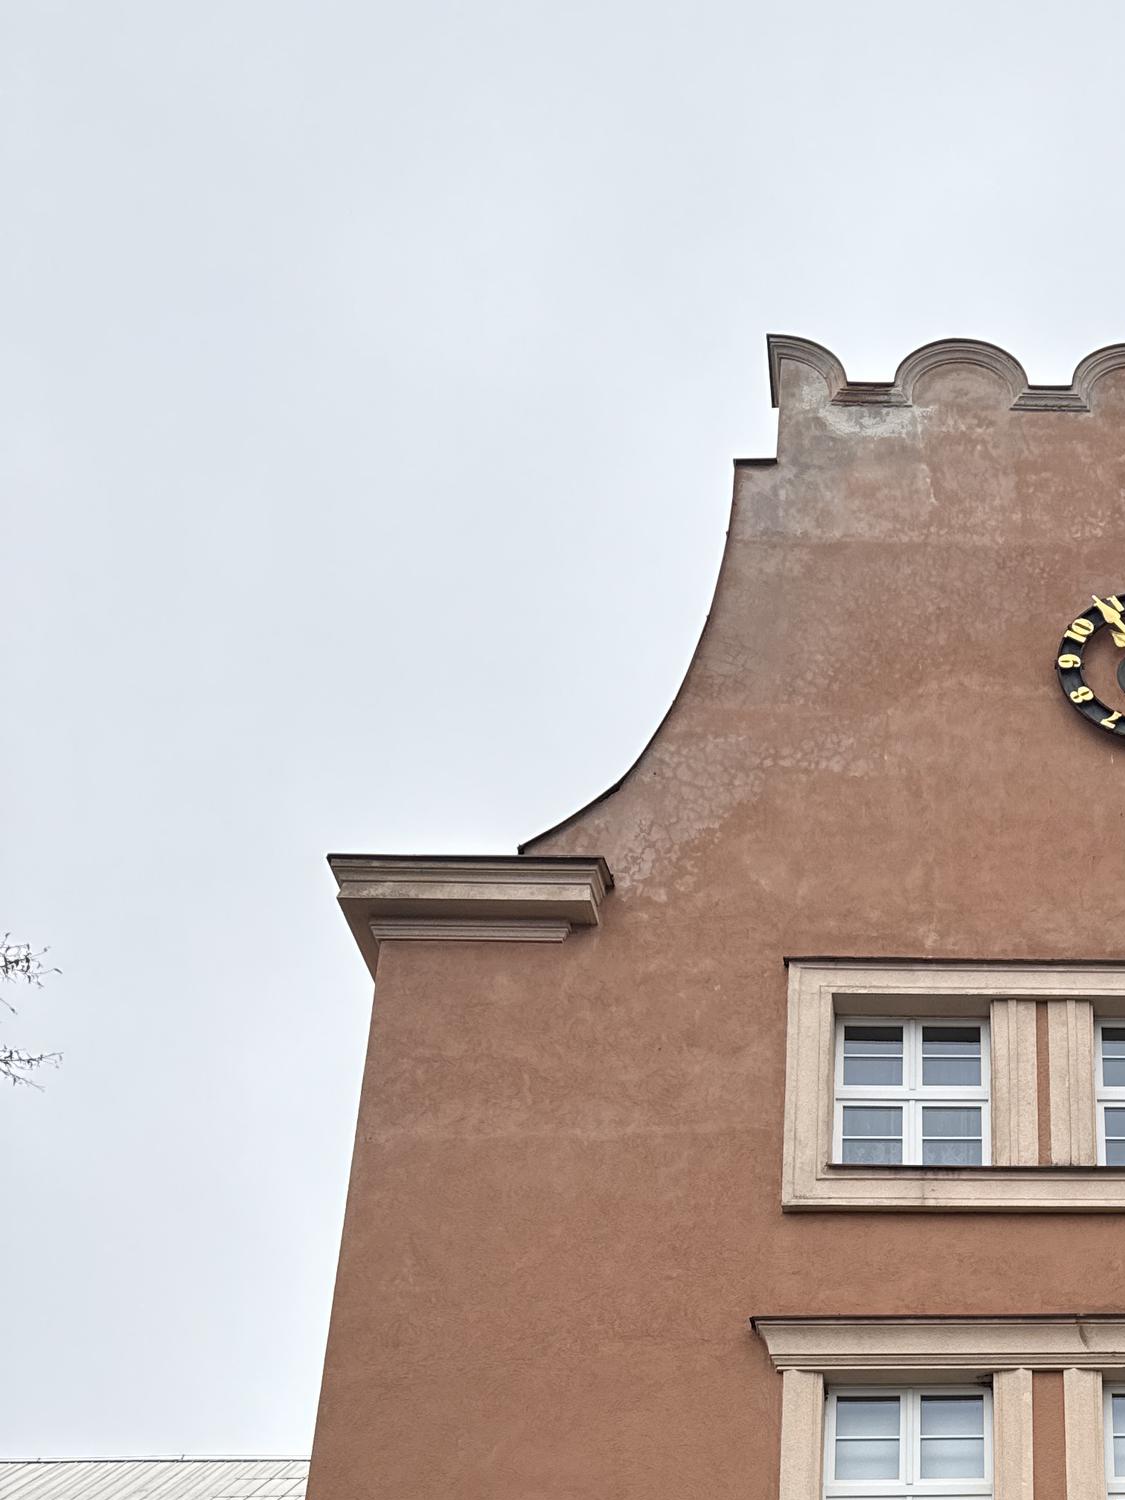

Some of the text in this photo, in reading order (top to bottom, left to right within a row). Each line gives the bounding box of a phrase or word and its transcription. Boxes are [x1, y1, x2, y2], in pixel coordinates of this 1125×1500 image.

[1064, 618, 1094, 643] 10
[1058, 654, 1081, 668] 9
[1069, 686, 1094, 703] 8
[1100, 711, 1122, 729] 7
